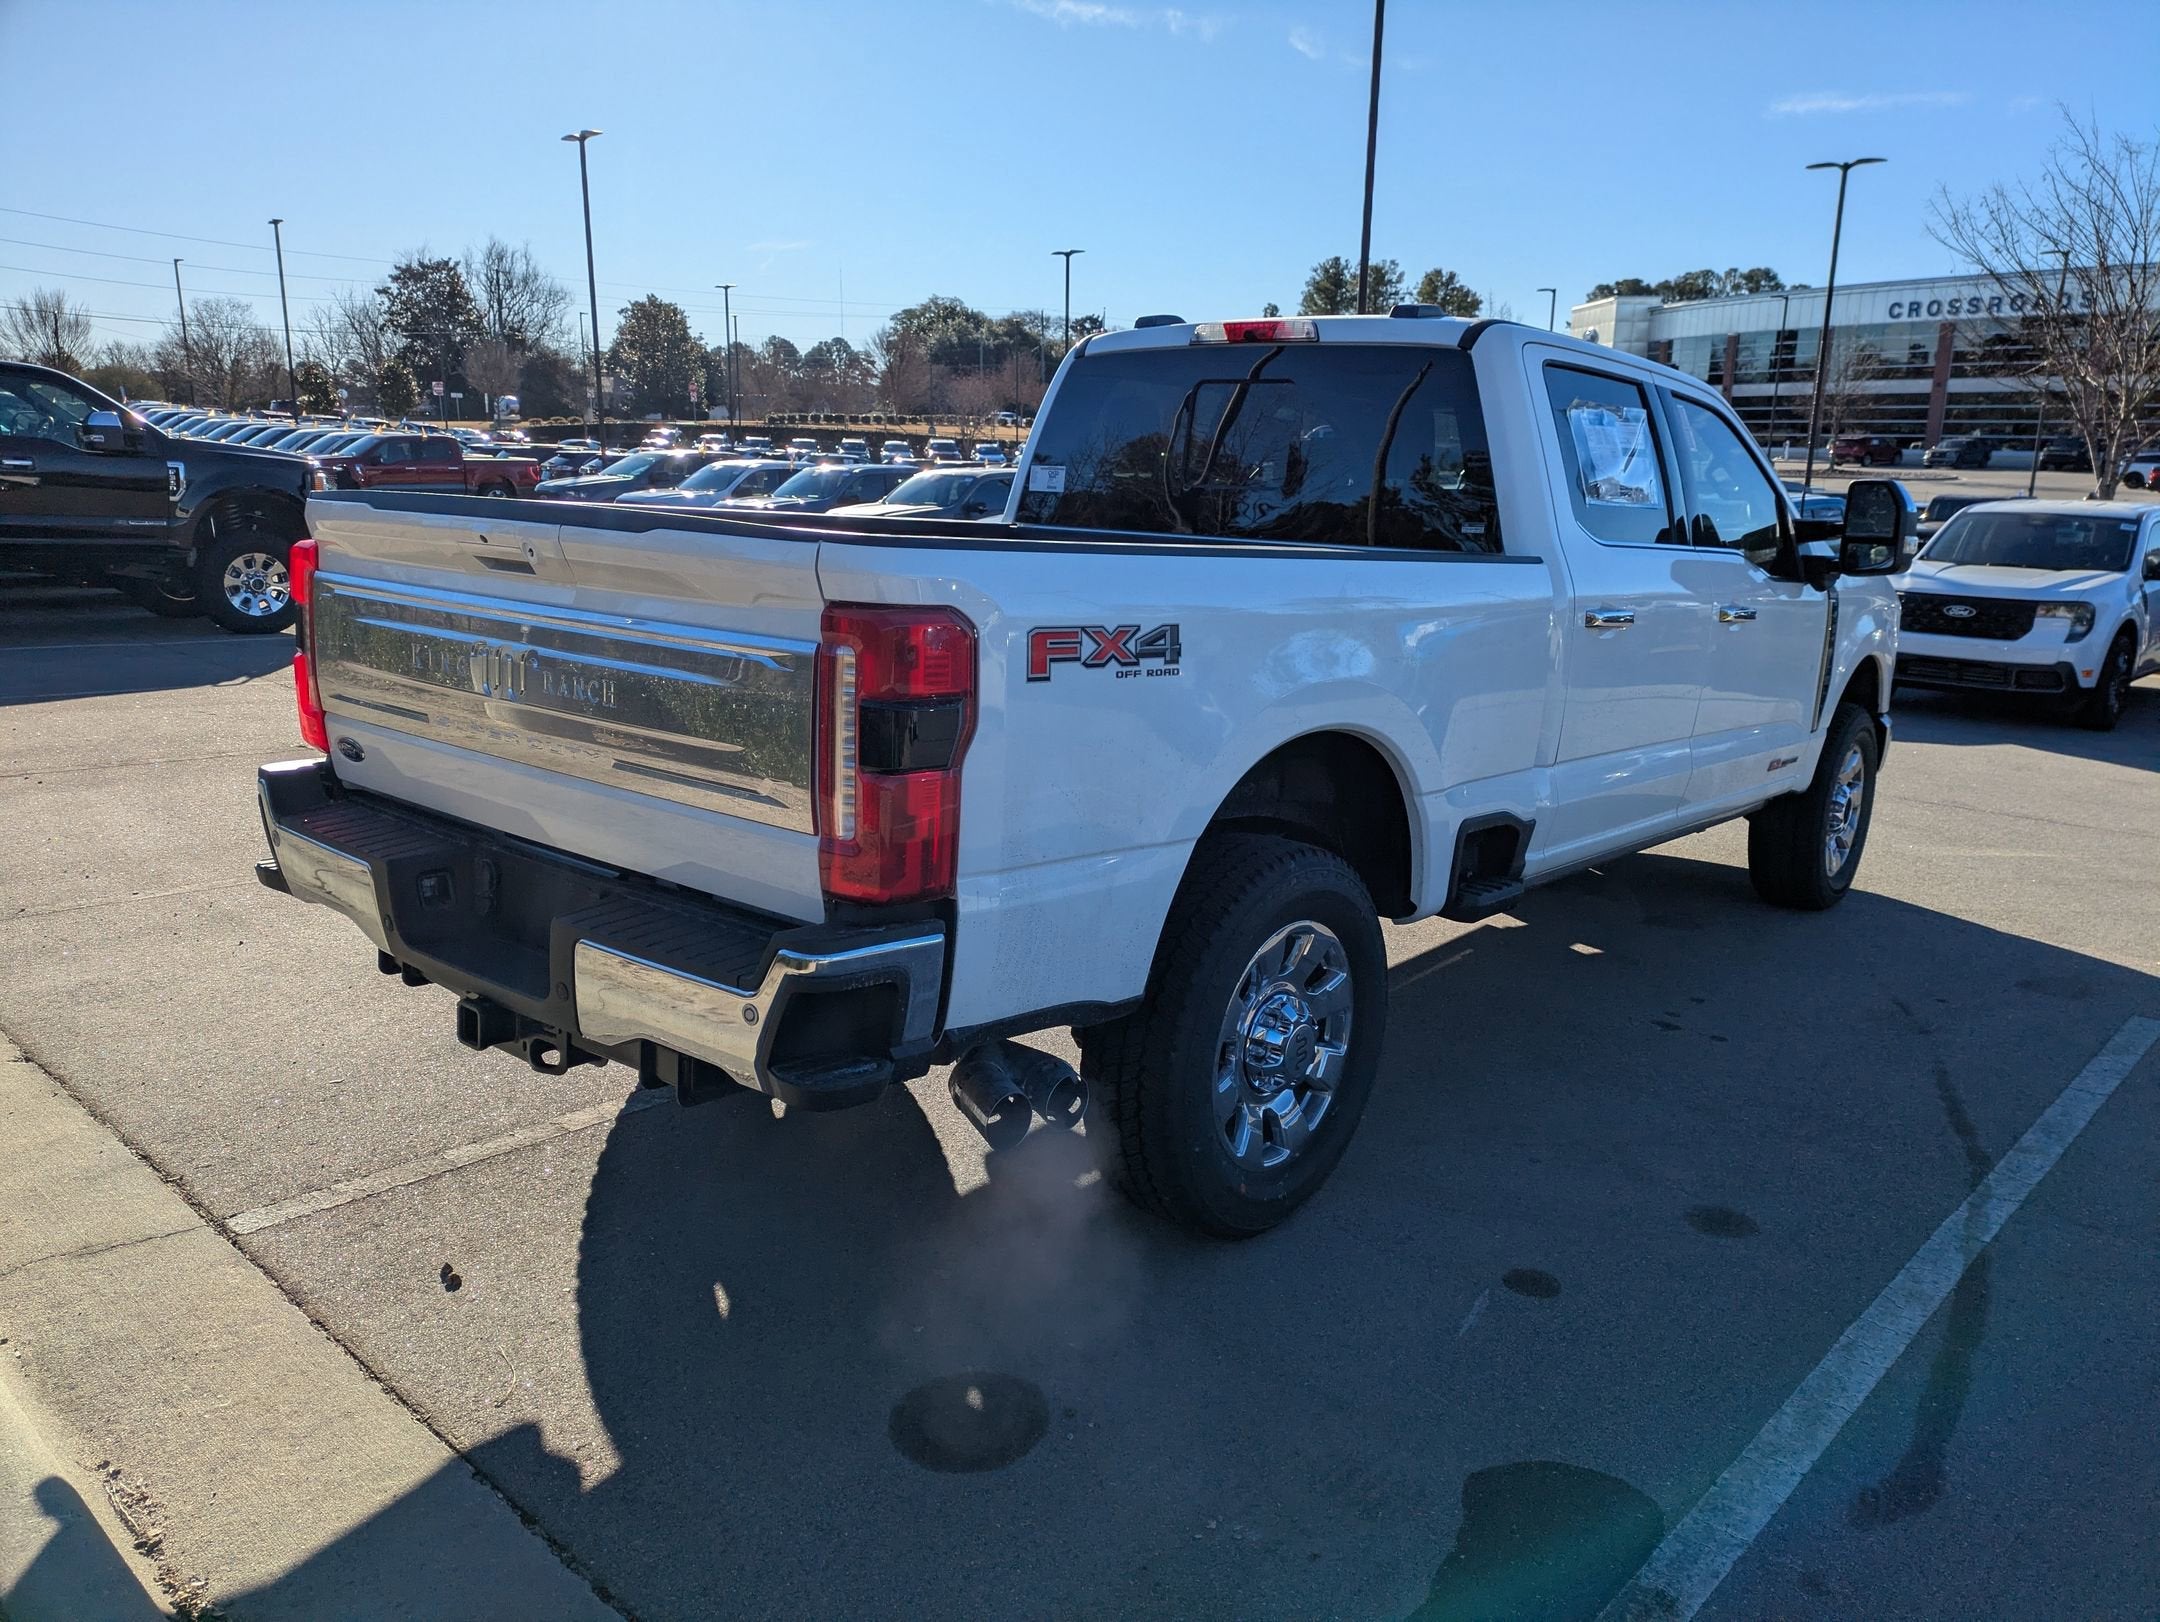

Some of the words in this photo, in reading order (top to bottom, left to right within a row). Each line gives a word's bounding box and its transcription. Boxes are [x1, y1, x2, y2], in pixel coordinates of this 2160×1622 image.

[1026, 624, 1182, 682] FX4
[542, 670, 617, 709] RANCH
[1115, 669, 1142, 679] OFF
[1146, 667, 1180, 678] ROAD
